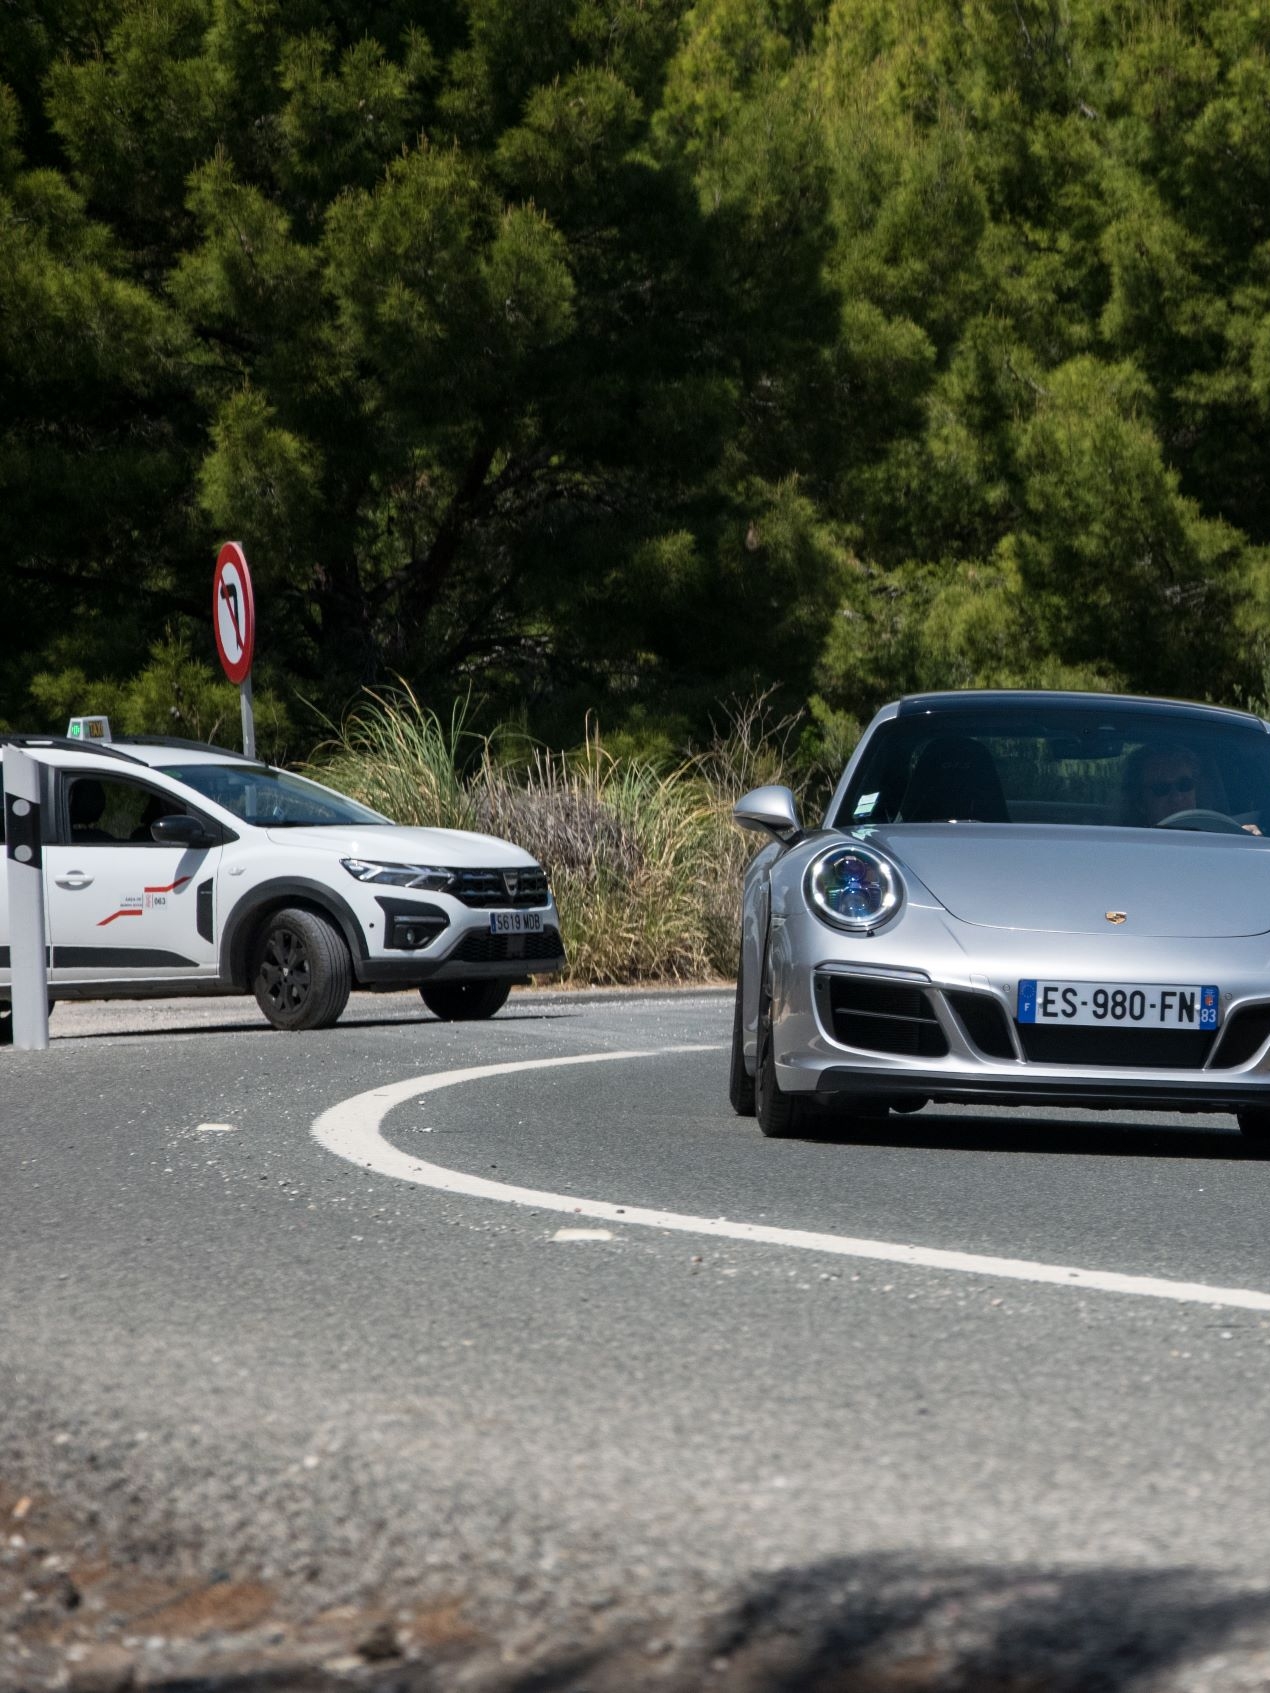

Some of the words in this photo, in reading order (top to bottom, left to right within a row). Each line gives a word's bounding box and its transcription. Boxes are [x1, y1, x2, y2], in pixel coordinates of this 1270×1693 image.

[497, 914, 520, 930] 5619
[522, 913, 541, 930] MDB
[1023, 1002, 1031, 1012] F
[1042, 986, 1196, 1023] ES-980-FN
[1201, 1008, 1217, 1023] 83
